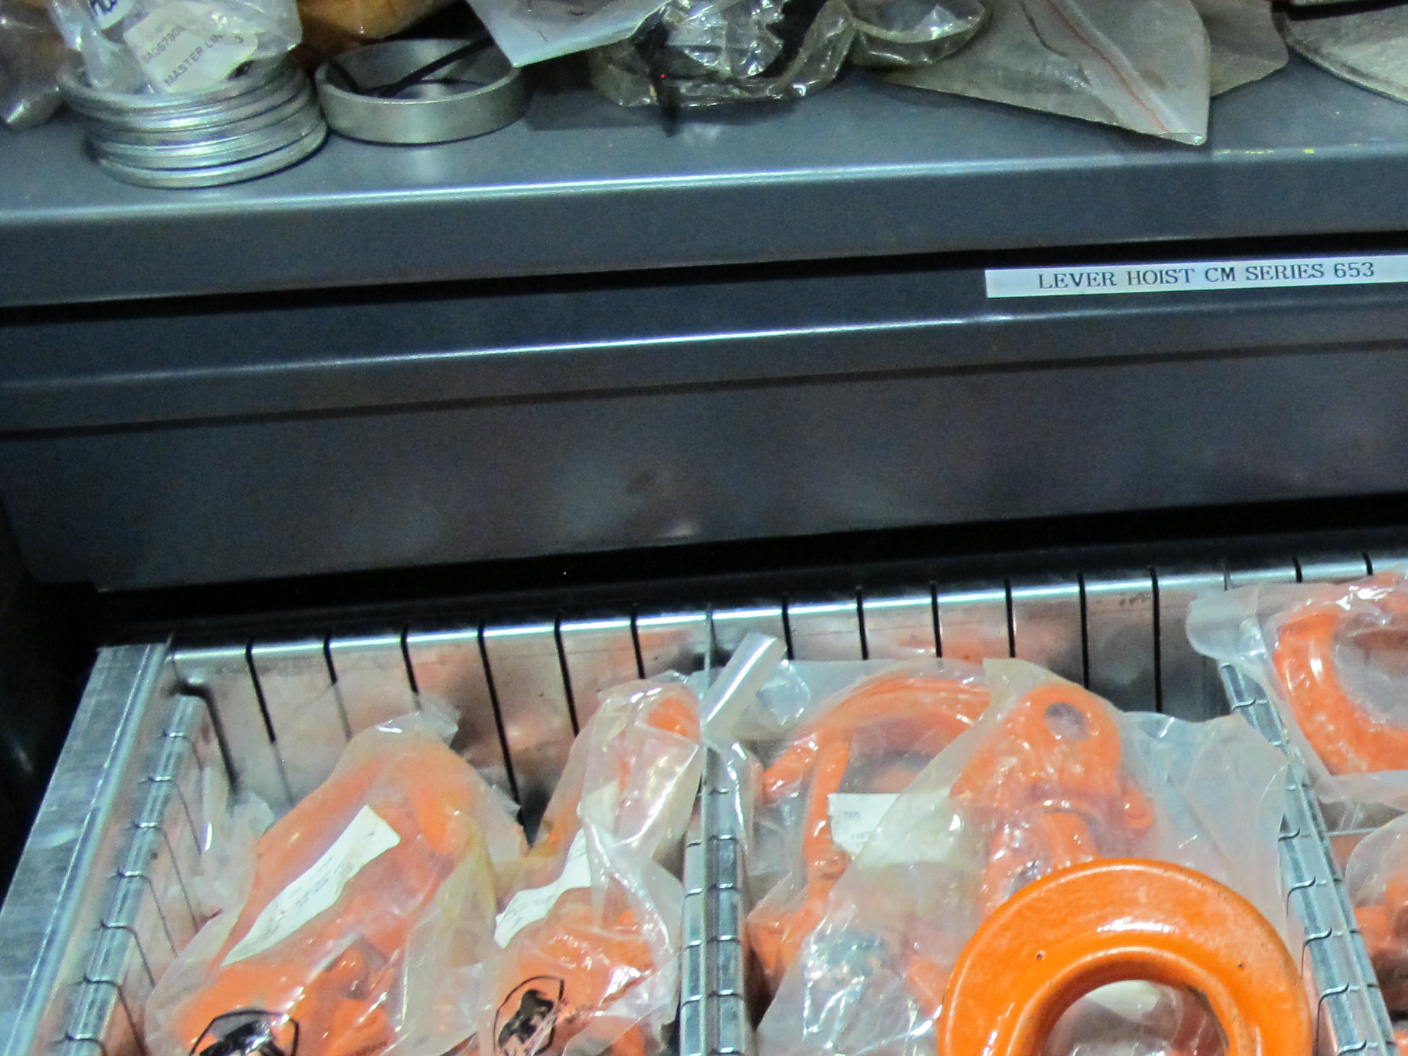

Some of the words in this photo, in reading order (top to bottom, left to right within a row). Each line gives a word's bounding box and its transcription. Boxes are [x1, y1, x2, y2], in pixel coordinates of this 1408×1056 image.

[1037, 271, 1118, 289] LEVER
[1126, 267, 1196, 287] HOIST
[1204, 266, 1237, 283] CM
[1245, 263, 1325, 281] SERIES
[1333, 261, 1376, 279] 653
